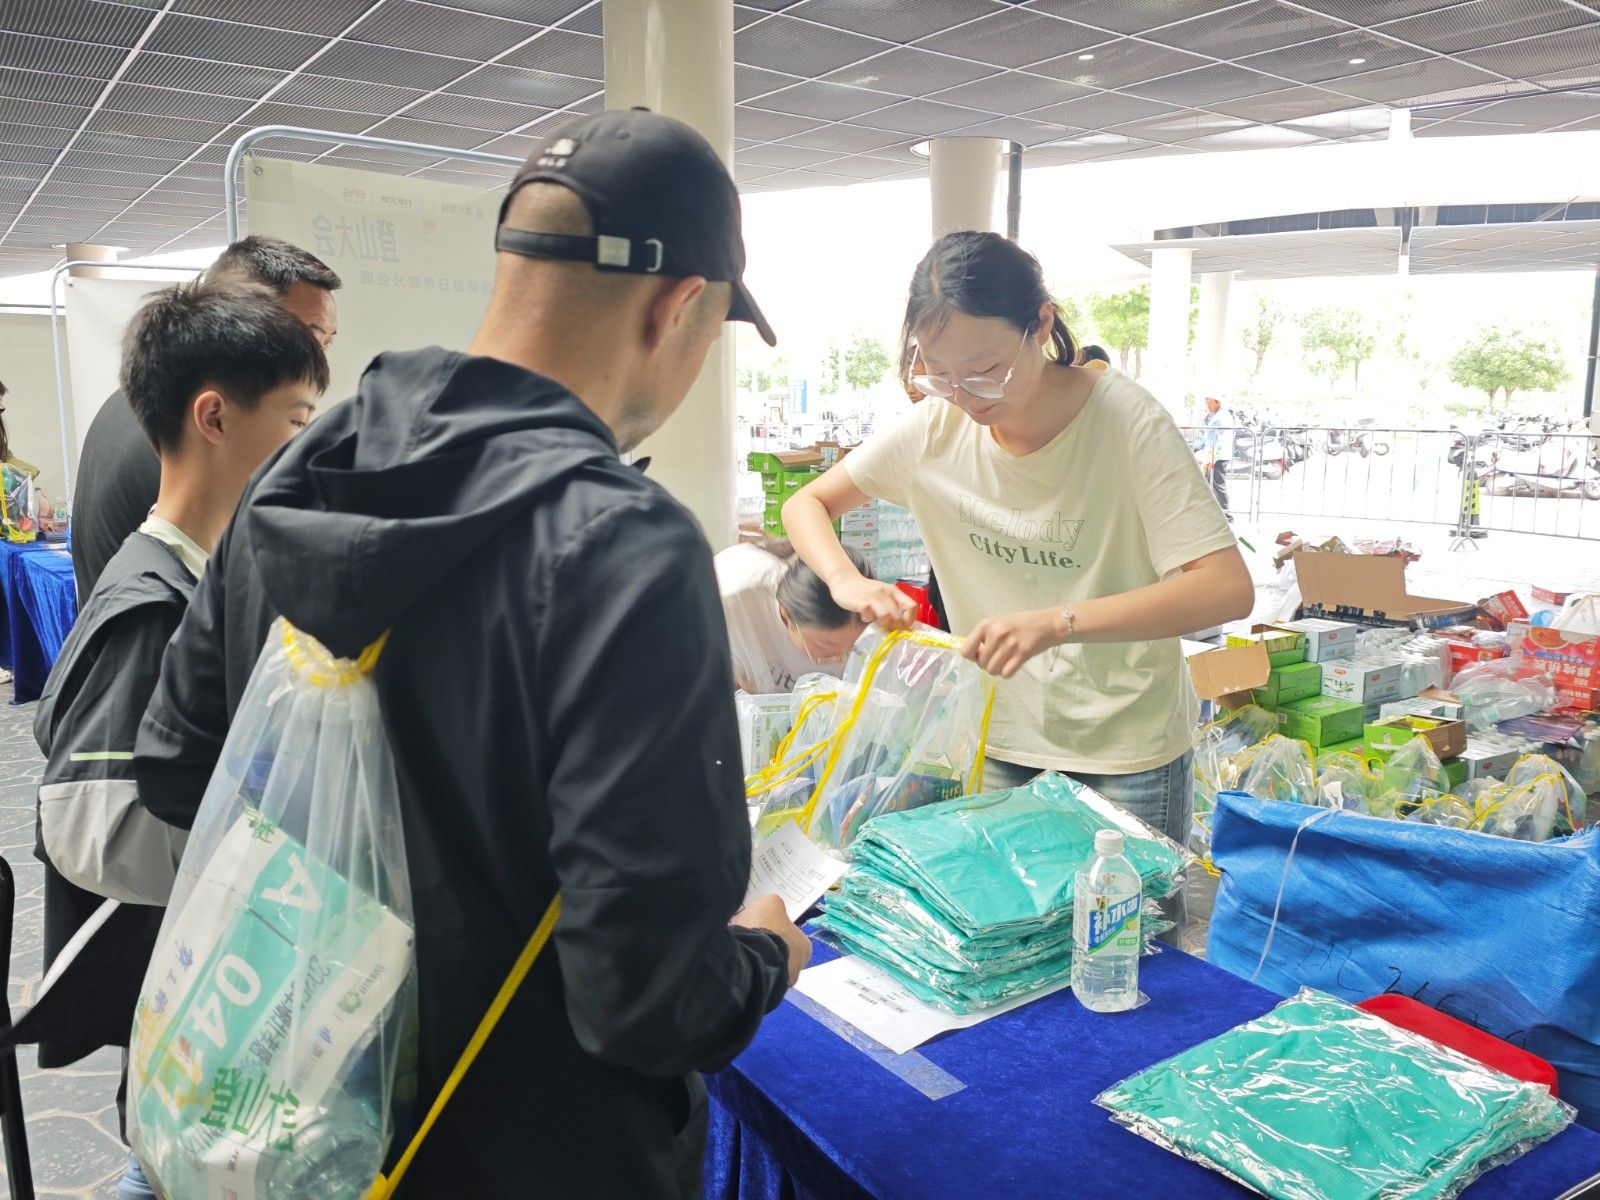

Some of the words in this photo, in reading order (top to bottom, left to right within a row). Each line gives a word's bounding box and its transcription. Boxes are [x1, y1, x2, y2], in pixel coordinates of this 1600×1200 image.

[958, 494, 1085, 551] Melody
[969, 533, 1017, 563] City
[1019, 545, 1081, 568] Life.
[260, 852, 323, 912] A
